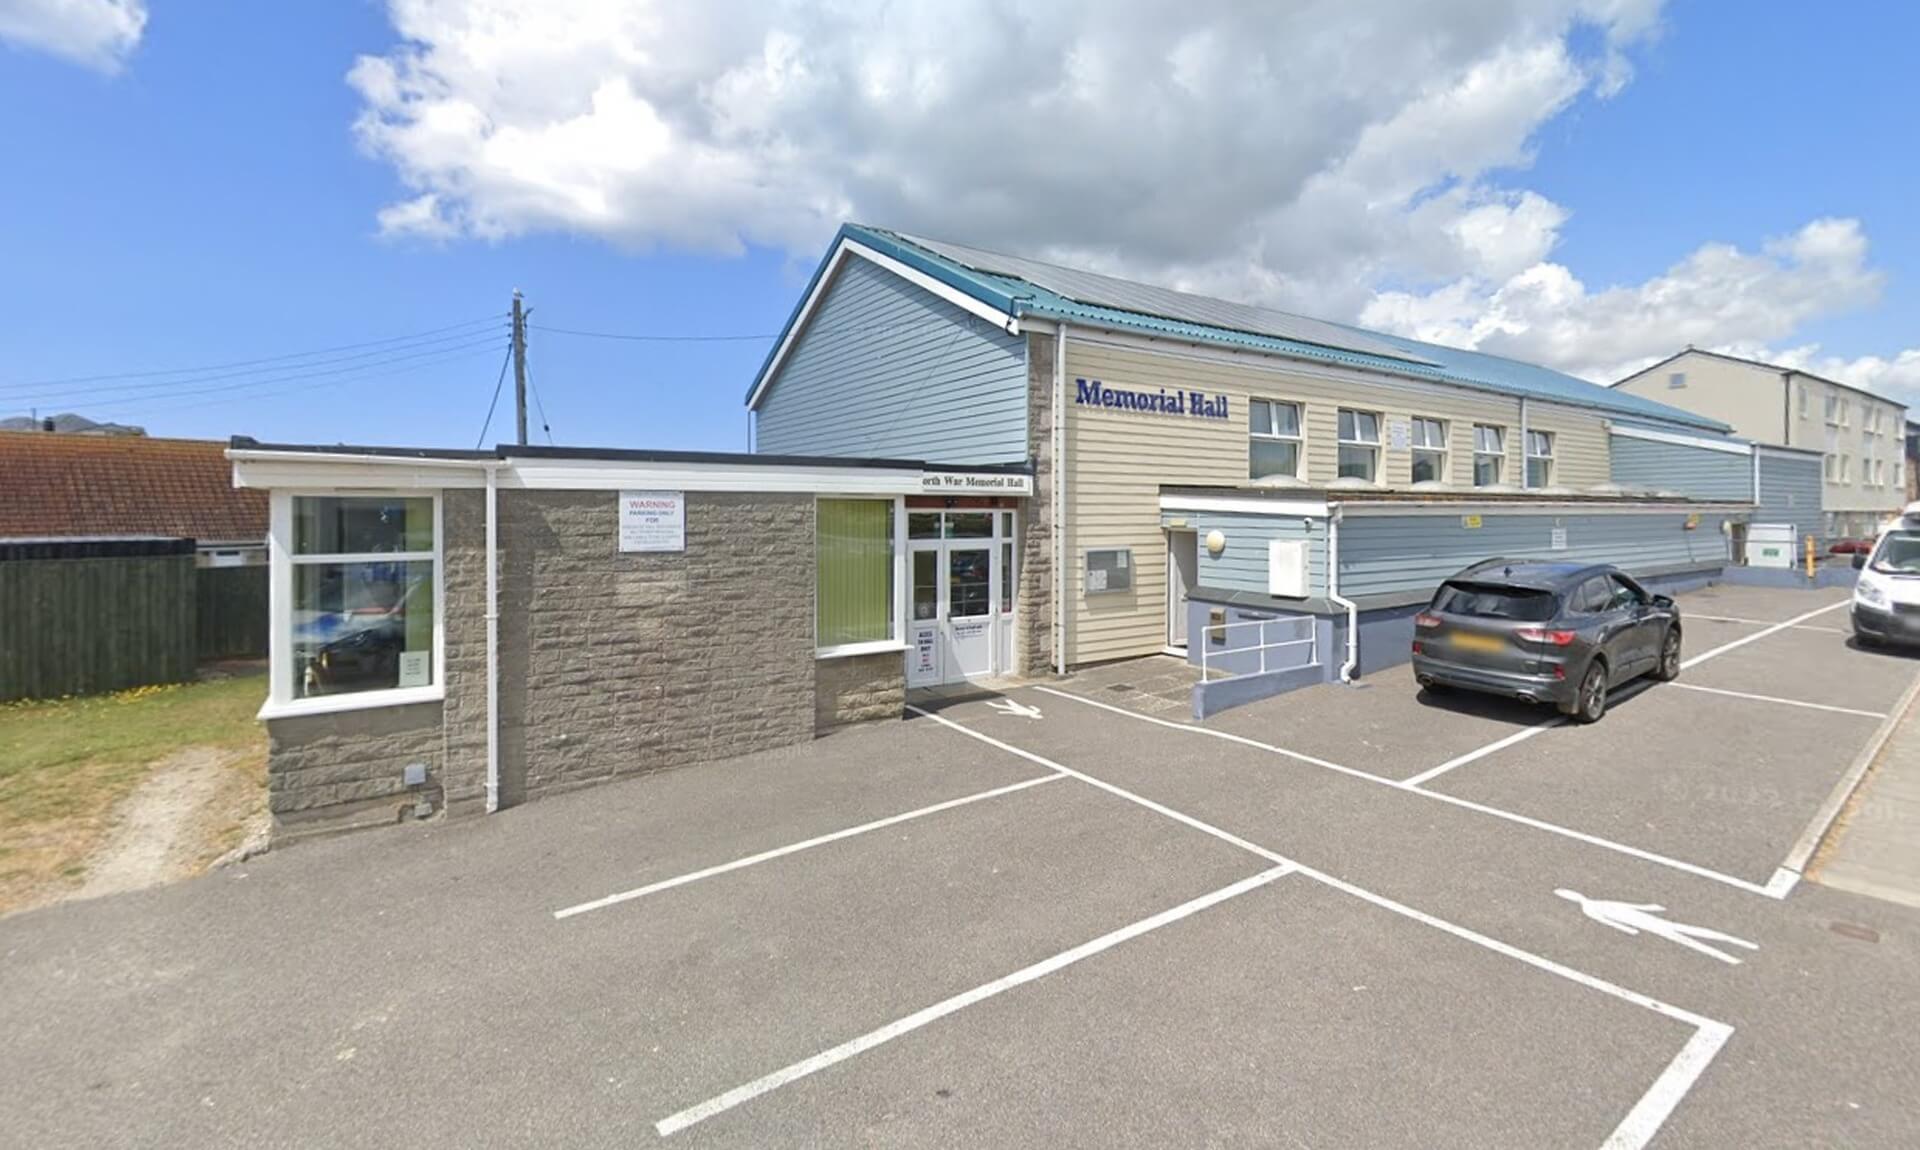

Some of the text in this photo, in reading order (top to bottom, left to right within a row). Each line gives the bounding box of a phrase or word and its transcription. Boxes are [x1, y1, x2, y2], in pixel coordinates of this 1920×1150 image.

[1075, 378, 1229, 418] Memorial Hall
[944, 475, 963, 486] War
[966, 476, 1004, 488] Memorial
[1007, 478, 1025, 488] Hall
[629, 500, 676, 509] WARNING
